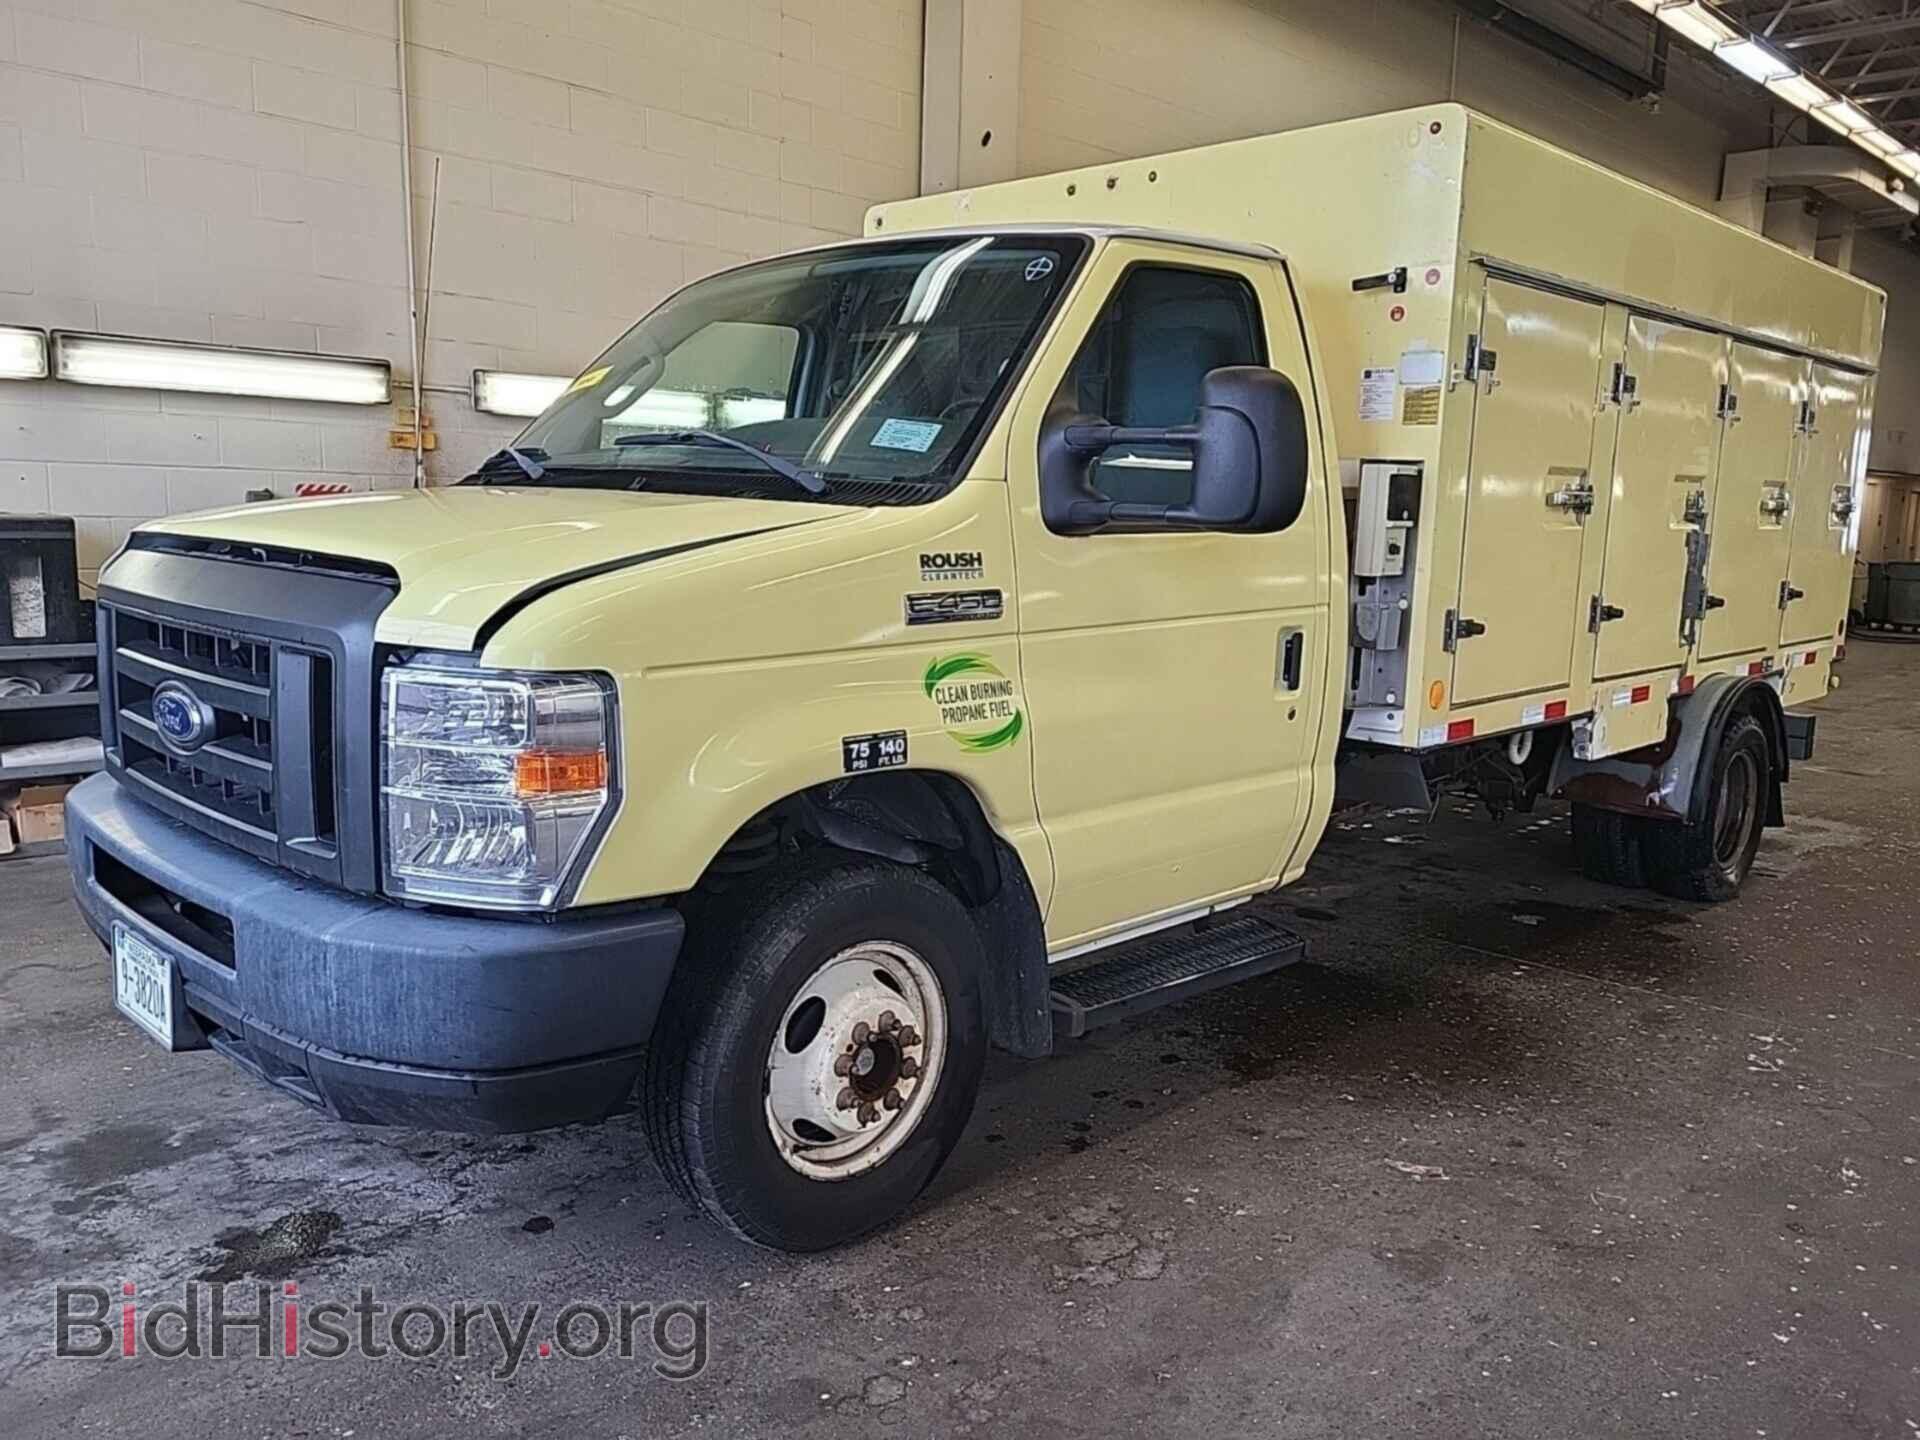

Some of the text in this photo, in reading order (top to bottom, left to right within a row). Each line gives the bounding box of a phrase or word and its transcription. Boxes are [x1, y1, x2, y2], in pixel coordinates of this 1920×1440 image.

[920, 552, 982, 568] ROUSH
[921, 571, 984, 581] CLEANTECH
[935, 680, 1012, 704] CLEAN BURNING
[159, 698, 184, 731] Ford
[942, 700, 1013, 724] PROPANE FUEL
[848, 738, 905, 759] 75 140
[852, 759, 868, 770] PSI
